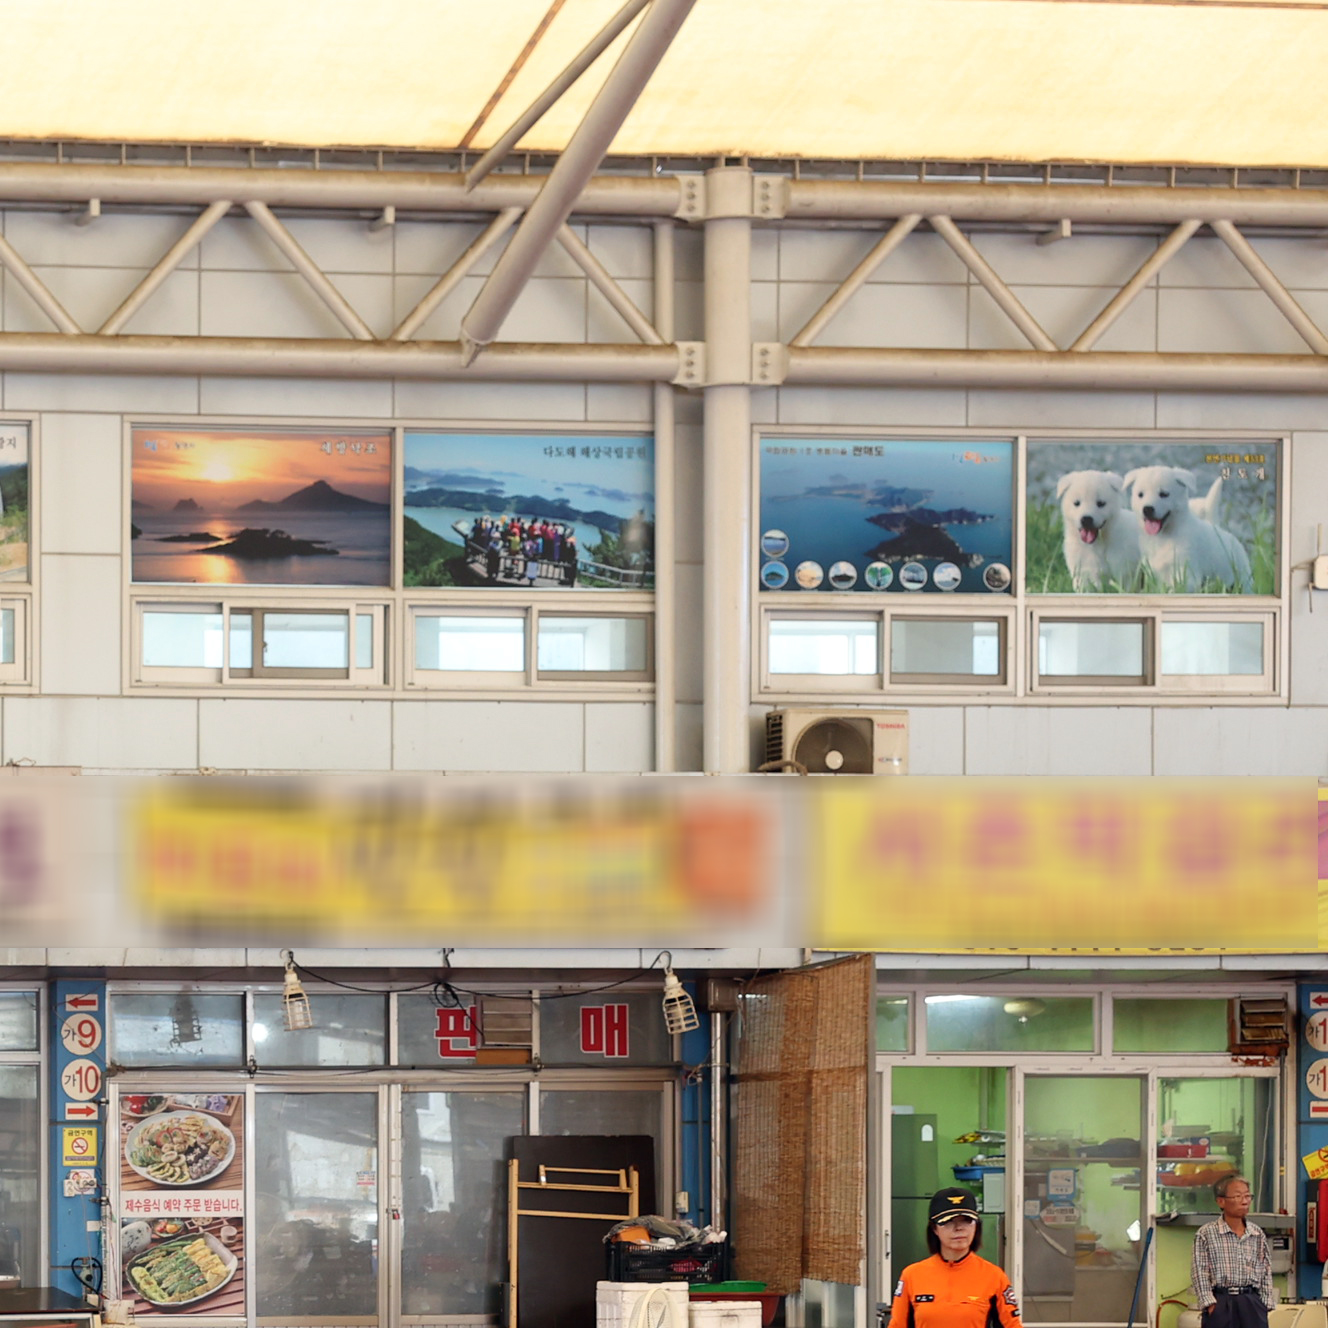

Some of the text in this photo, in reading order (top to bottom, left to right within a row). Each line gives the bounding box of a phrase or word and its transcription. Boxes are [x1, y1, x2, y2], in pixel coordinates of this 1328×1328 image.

[543, 445, 576, 458] 다도해
[1307, 1018, 1328, 1045] 가1
[1308, 1065, 1328, 1092] 가1
[68, 1129, 93, 1137] 금연구역
[125, 1198, 243, 1213] 제수음식 예약 주문 받습니다.
